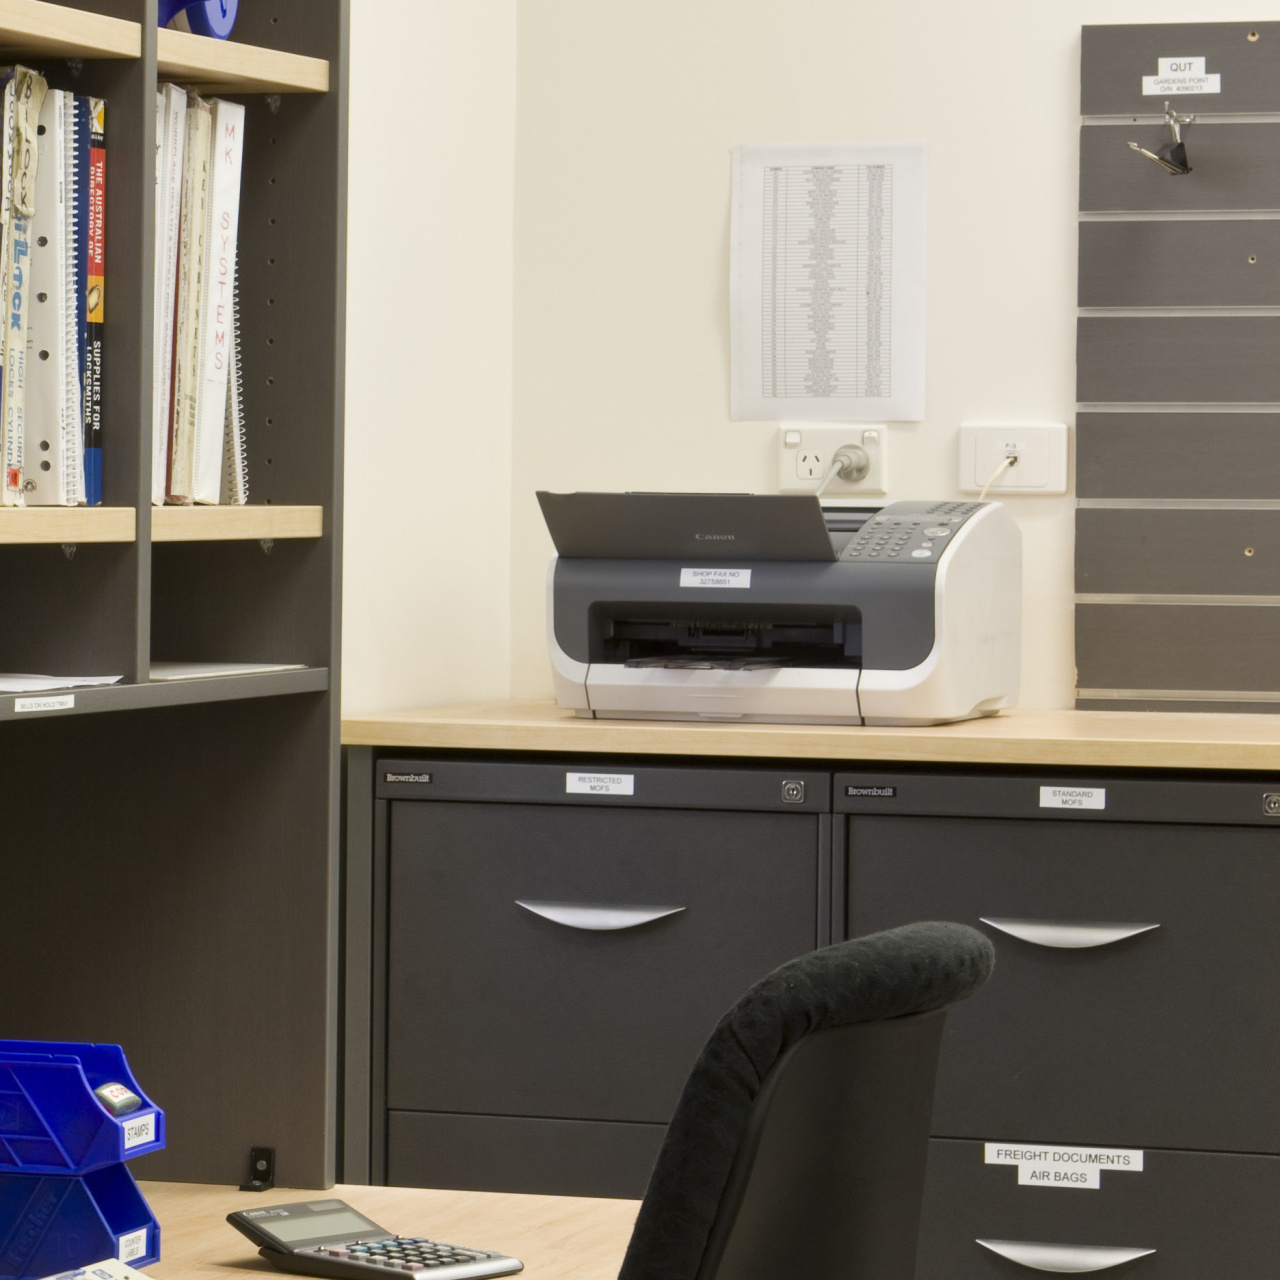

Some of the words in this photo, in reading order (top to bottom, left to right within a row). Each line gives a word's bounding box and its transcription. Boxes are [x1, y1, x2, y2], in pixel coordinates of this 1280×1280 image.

[1170, 62, 1193, 72] QUT
[95, 161, 103, 186] THE
[94, 188, 103, 264] AUSTRALIAN
[87, 245, 94, 258] OF
[214, 211, 230, 371] SYSTEMS
[7, 347, 15, 398] LOCKS
[92, 340, 102, 402] SUPPLIES
[85, 346, 93, 425] LOCKSMITHS
[92, 405, 101, 431] FOR
[695, 533, 735, 541] Canon
[386, 773, 430, 783] Brownbuilt
[577, 775, 623, 785] RESTRICTED
[589, 784, 610, 793] MOFS
[848, 786, 894, 796] Brownbuilt
[1051, 789, 1094, 799] STANDARD
[1061, 798, 1083, 807] MOFS
[127, 1121, 150, 1141] STAMPS
[996, 1149, 1050, 1161] FREIGHT
[1052, 1152, 1132, 1166] DOCUMENTS
[1030, 1170, 1050, 1181] AIR
[1053, 1171, 1088, 1184] BAGS
